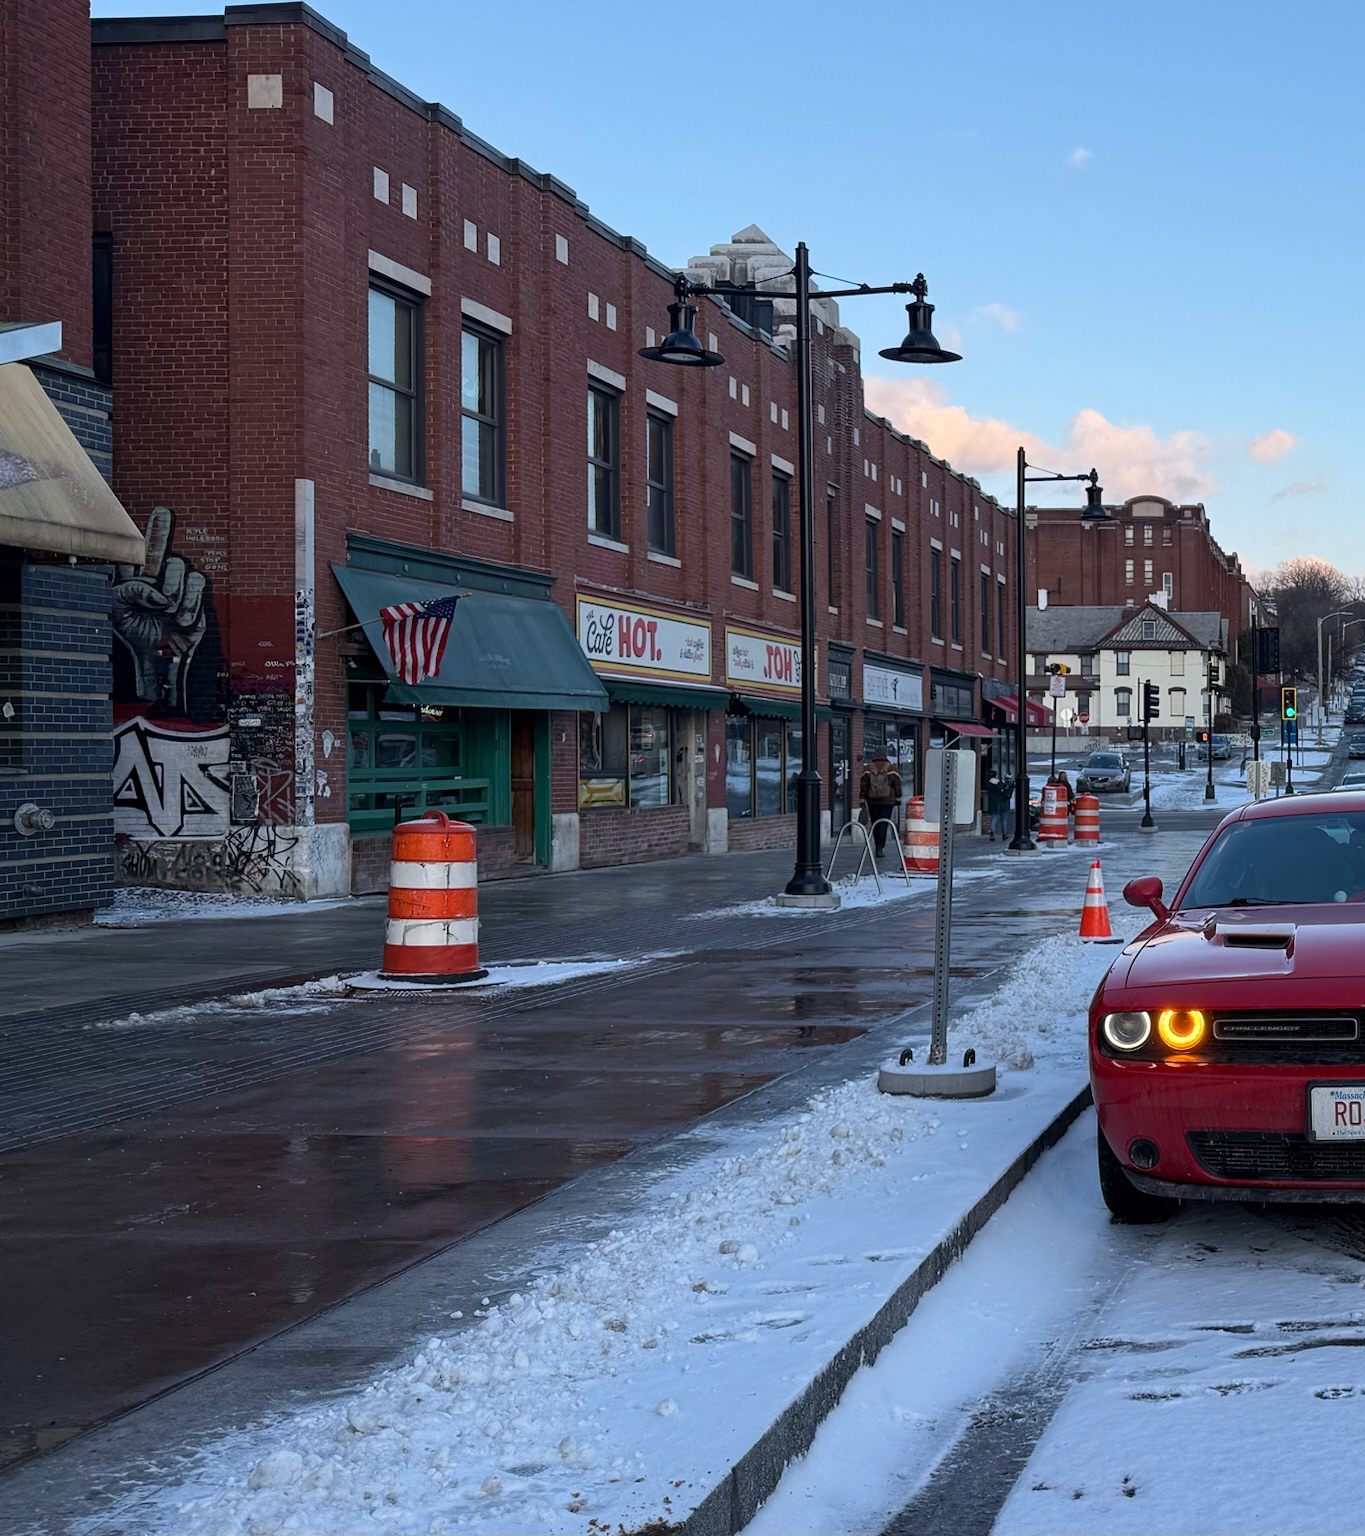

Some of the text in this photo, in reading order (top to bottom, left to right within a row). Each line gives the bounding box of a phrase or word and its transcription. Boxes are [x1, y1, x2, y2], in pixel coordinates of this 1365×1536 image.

[186, 527, 208, 535] KYLE
[586, 613, 662, 661] Café HOT.
